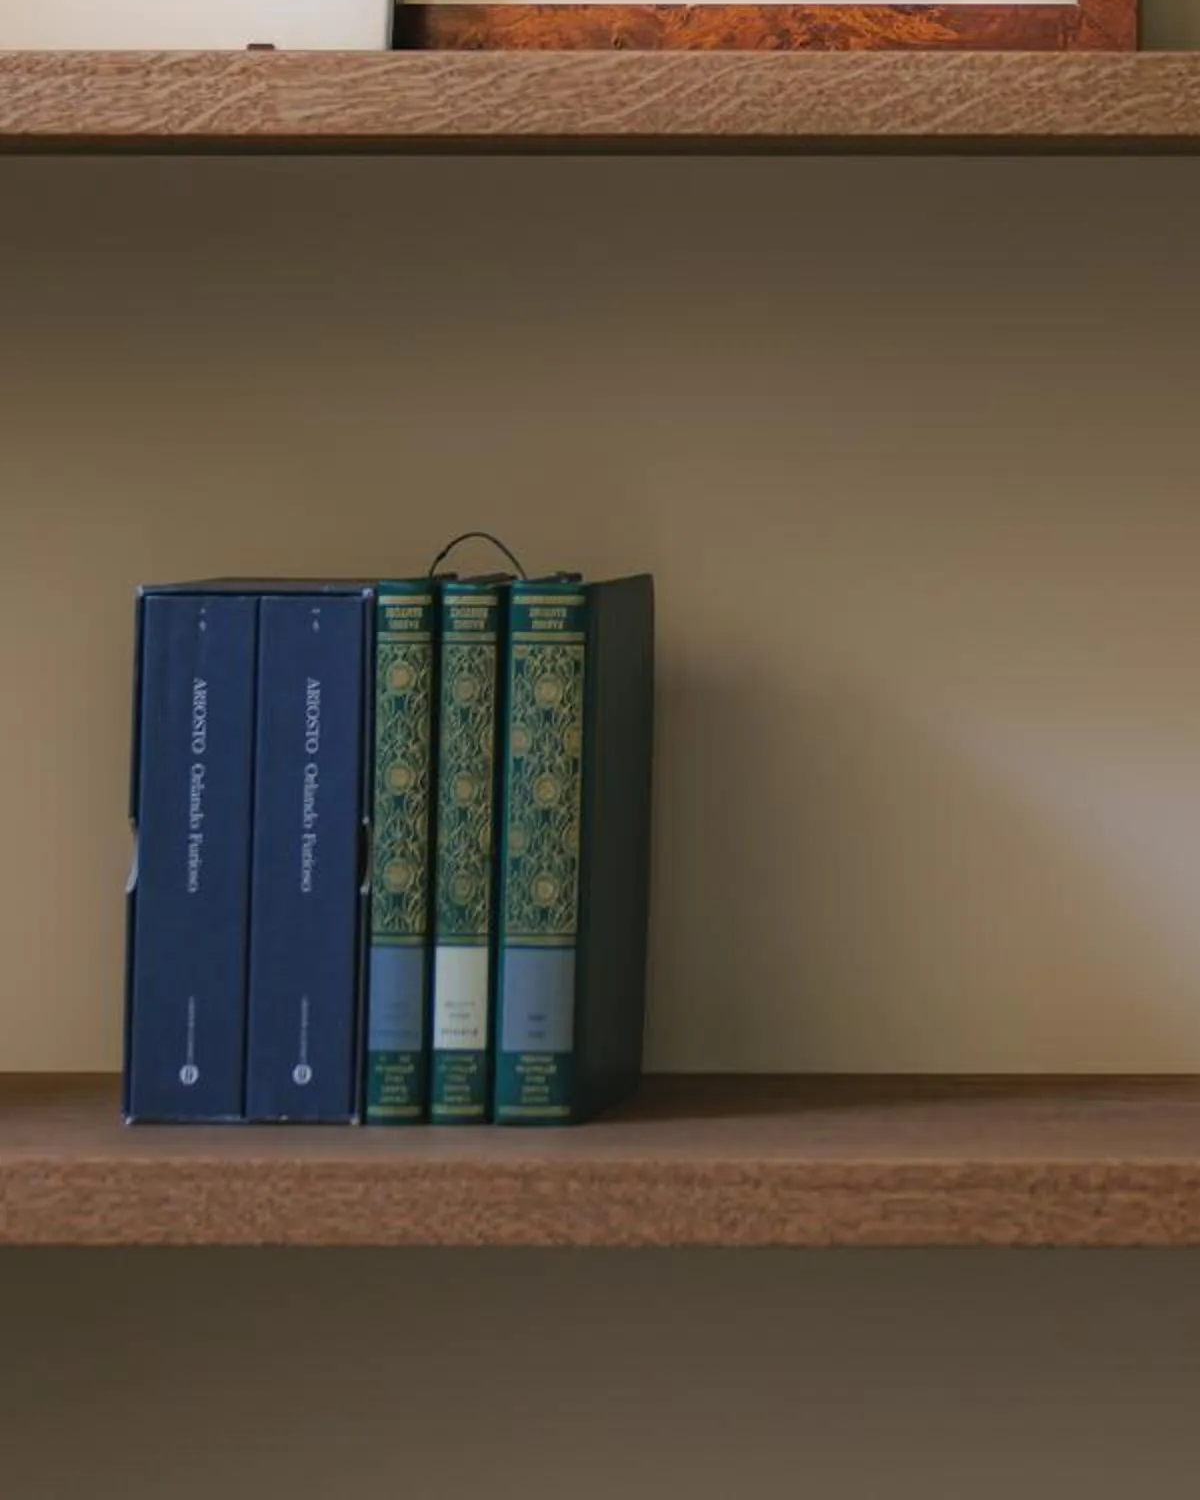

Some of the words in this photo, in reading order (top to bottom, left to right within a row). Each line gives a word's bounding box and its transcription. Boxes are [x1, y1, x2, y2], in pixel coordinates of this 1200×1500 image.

[191, 677, 208, 755] ARIOSTO
[305, 677, 321, 754] ARIOSTO
[189, 762, 206, 830] Orlando
[303, 762, 320, 830] Orlando
[187, 832, 204, 894] Furioso
[300, 832, 317, 893] Furioso
